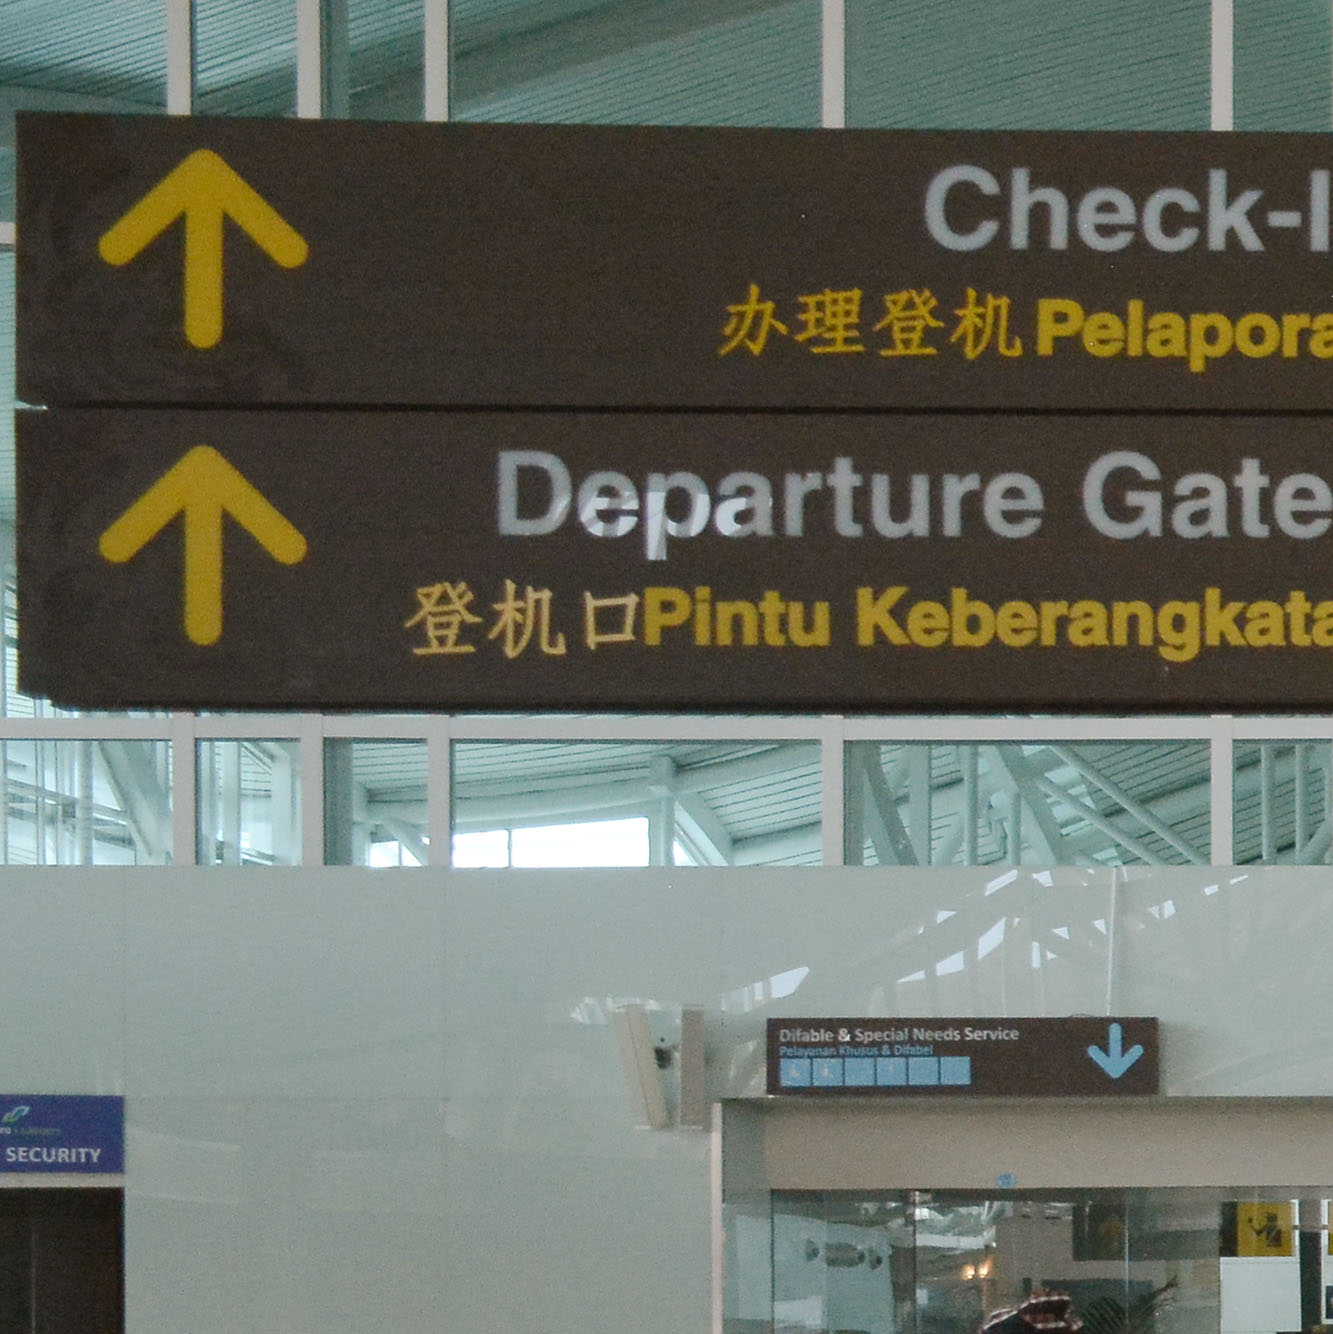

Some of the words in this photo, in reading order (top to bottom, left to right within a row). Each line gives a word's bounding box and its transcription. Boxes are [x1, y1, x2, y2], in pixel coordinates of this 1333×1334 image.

[719, 283, 1025, 361] 办理登机
[498, 451, 1044, 561] Departure
[406, 580, 640, 660] 登机口
[643, 586, 832, 648] Pintu
[779, 1028, 833, 1043] Difable
[838, 1028, 851, 1042] &
[855, 1027, 908, 1044] Special
[913, 1027, 961, 1041] Needs
[965, 1025, 1020, 1041] Service
[6, 1147, 101, 1163] SECURITY
